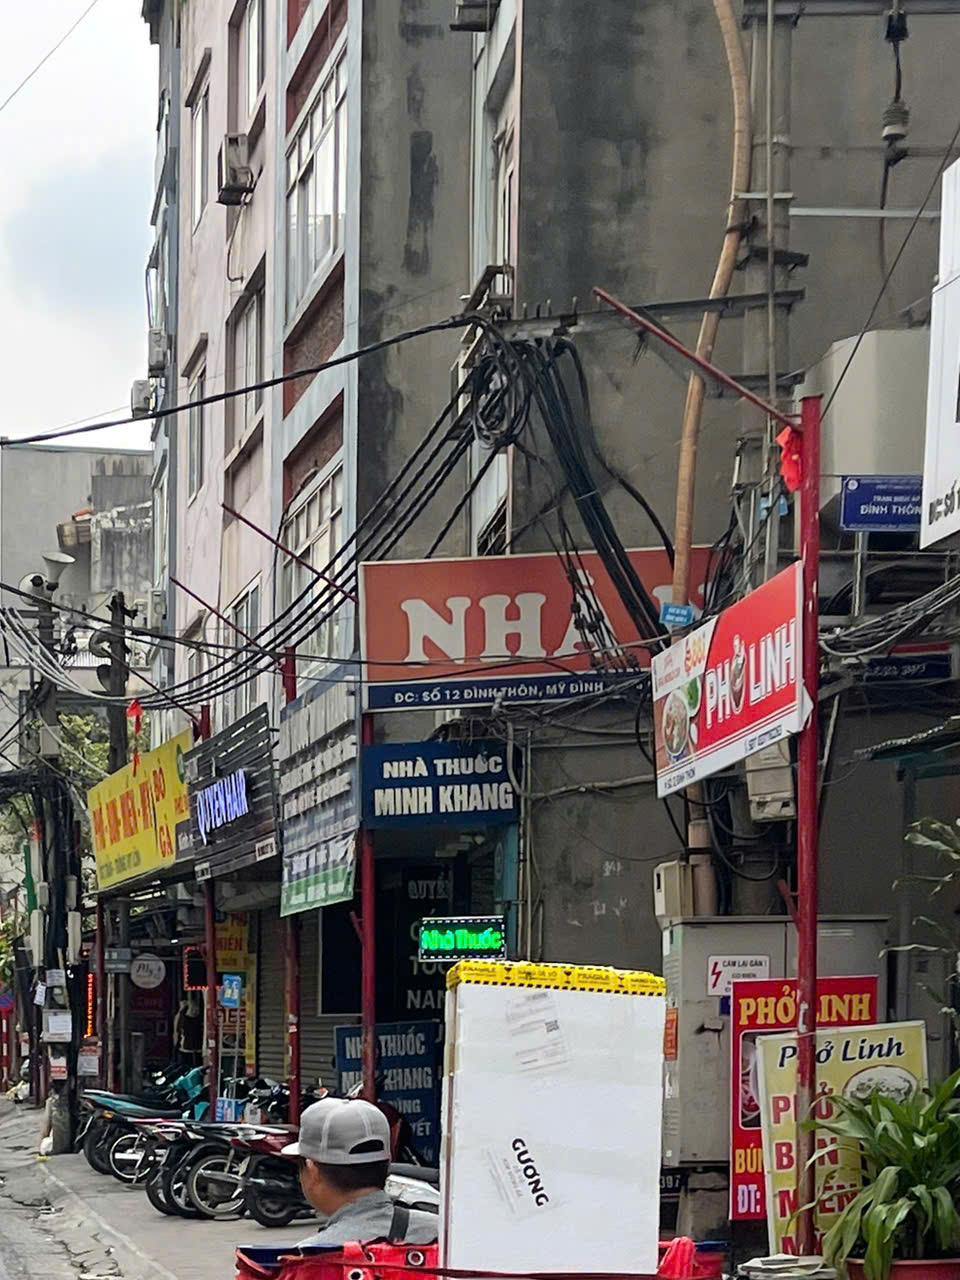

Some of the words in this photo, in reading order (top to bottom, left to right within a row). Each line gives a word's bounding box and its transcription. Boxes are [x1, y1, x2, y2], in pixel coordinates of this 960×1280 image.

[401, 569, 624, 667] NHÀ
[749, 617, 797, 707] LINH
[422, 687, 441, 702] SỐ
[444, 689, 461, 700] 12
[569, 679, 604, 694] ĐÌNH
[382, 756, 428, 779] NHÀ
[433, 751, 504, 777] THUỐC
[374, 786, 433, 816] MINH
[439, 782, 514, 813] KHANG
[738, 984, 796, 1027] PHỞ
[816, 993, 872, 1023] INH
[378, 1026, 425, 1057] THUỐC
[778, 1041, 834, 1068] Pở
[841, 1037, 905, 1062] Linh
[383, 1066, 433, 1091] KHANG
[772, 1081, 834, 1125] PỞ
[775, 1136, 839, 1171] BN
[512, 1138, 549, 1207] GƯƠNG
